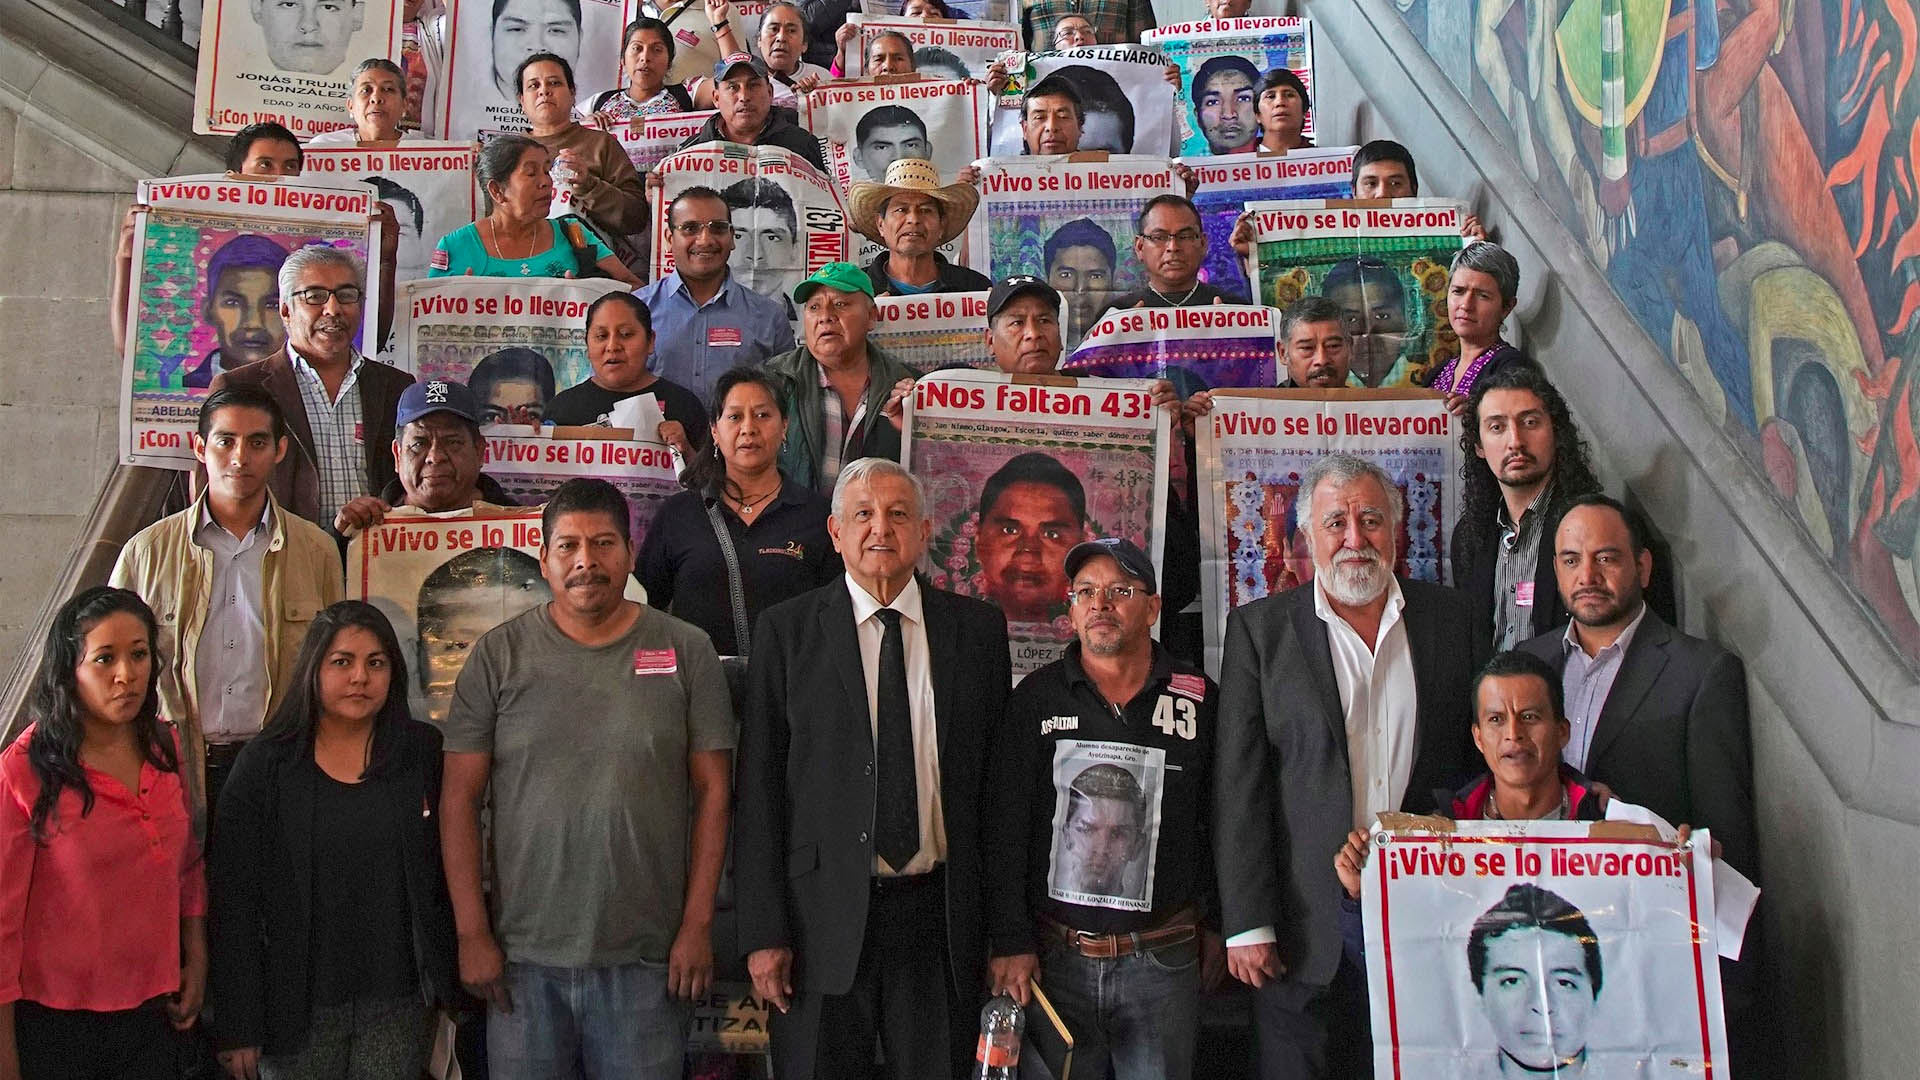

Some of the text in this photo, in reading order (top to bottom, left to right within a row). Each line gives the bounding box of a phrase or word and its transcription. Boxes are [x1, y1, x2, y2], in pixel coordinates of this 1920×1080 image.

[1196, 20, 1211, 33] se
[1216, 18, 1230, 32] lo
[1235, 16, 1300, 30] llevaron!
[910, 32, 925, 44] se
[930, 31, 944, 45] lo
[1069, 49, 1094, 60] LOS
[236, 72, 347, 90] JONÁS TRUJIL
[260, 84, 350, 98] GONZÁLEZ
[263, 99, 294, 108] EDAD
[315, 102, 345, 113] AÑOS
[812, 82, 971, 109] ¡Vivo se lo llevaron!
[218, 109, 248, 125] ¡Con
[291, 117, 303, 131] lo
[485, 106, 523, 114] MIGU
[493, 116, 531, 124] HERN
[624, 124, 703, 142] lo llevar
[341, 155, 361, 172] se
[368, 154, 384, 171] lo
[390, 153, 469, 171] llevaron!
[666, 155, 714, 174] ¡Vivo
[719, 159, 738, 173] se
[743, 158, 757, 176] lo
[1233, 165, 1251, 181] se
[1256, 163, 1272, 180] lo
[1277, 157, 1353, 178] llevaron!
[837, 162, 850, 201] falta
[982, 170, 1171, 195] ¡Vivo se lo llevaron!
[152, 183, 368, 213] ¡Vivo se lo llevaron!
[806, 206, 843, 232] 43!
[1257, 208, 1456, 235] ¡Vivo se lo llevaron!
[413, 295, 593, 319] ¡Vivo se lo llevar
[907, 302, 929, 321] se
[936, 298, 954, 318] lo
[962, 296, 987, 317] lle
[1121, 315, 1143, 332] se
[1150, 310, 1169, 331] lo
[1176, 309, 1268, 329] llevaron!
[151, 405, 200, 417] ABELAR
[916, 382, 1151, 420] ¡Nos faltan 43!
[1053, 428, 1079, 437] quiero
[1083, 430, 1104, 438] saber
[1214, 411, 1449, 439] ¡Vivo se lo llevaron!
[139, 429, 180, 450] ¡Con
[546, 444, 569, 463] se
[575, 443, 594, 465] lo
[601, 442, 673, 469] llevaro
[372, 522, 541, 557] ¡Vivo se lo lle
[1017, 646, 1052, 660] LÓPEZ
[1152, 695, 1197, 740] 43
[1101, 743, 1141, 754] desaparecido
[1390, 846, 1682, 880] ¡Vivo se lo llevaron!
